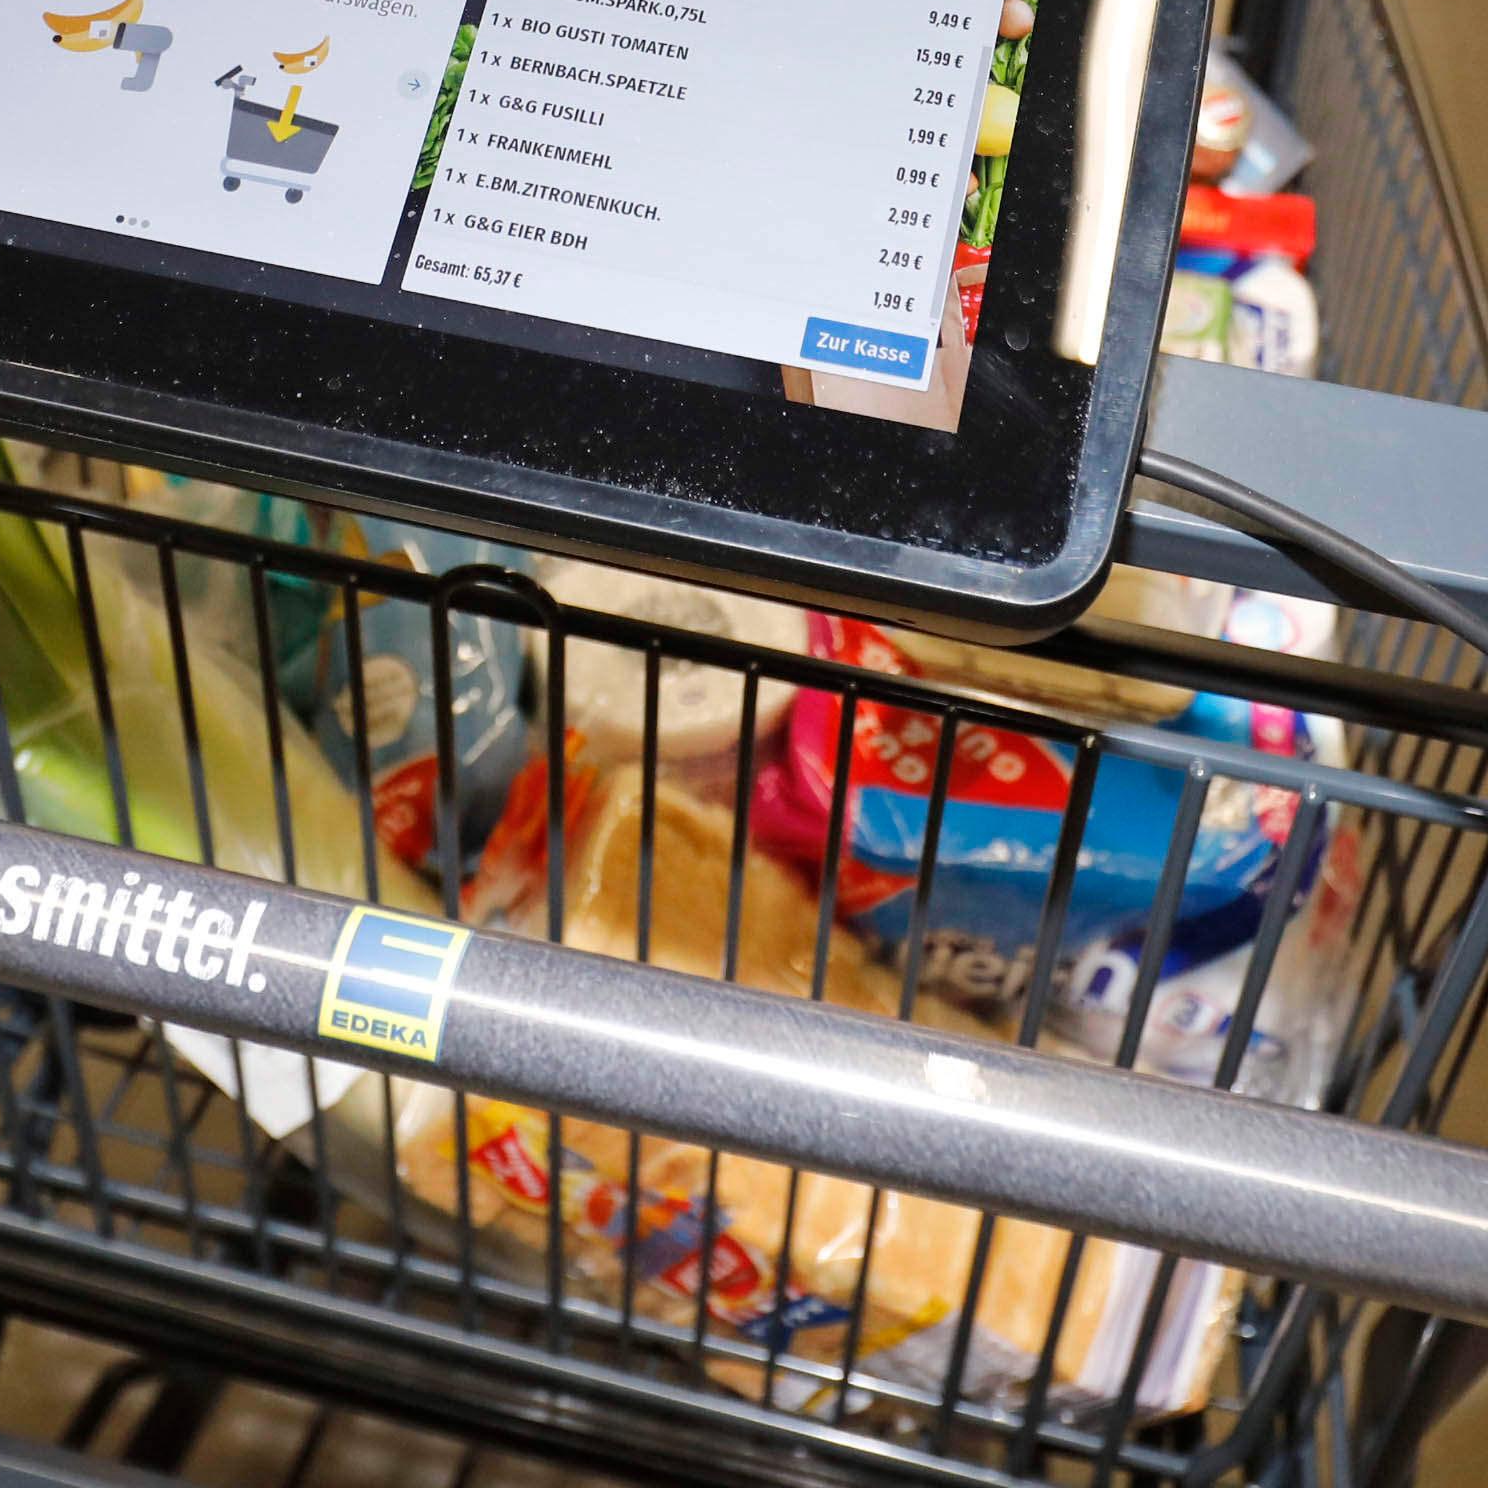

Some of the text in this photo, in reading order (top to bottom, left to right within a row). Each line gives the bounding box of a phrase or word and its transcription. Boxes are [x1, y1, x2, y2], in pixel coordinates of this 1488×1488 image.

[492, 12, 956, 108] 1 x BIO GUSTI TOMATEN 2,29 €
[916, 48, 951, 67] 15,99
[955, 55, 964, 69] €
[929, 10, 959, 28] 9,49
[962, 16, 972, 30] €
[469, 89, 940, 188] 1 x G&G FUSILLI 0,99 €
[481, 50, 948, 148] 1 x BERNBACH.SPAETZLE 1,99 €
[446, 168, 923, 270] 1 x E.BM.ZITRONENKUCH. 2,49 €
[457, 128, 932, 229] 1 x FRANKENMEHL 2,99 €
[414, 254, 523, 289] Gesamt: 65,37 €
[434, 208, 915, 312] 1 x G&G EIER BDH 1,99 €
[816, 332, 911, 364] Zur Kasse
[331, 1009, 428, 1049] EDEKA
